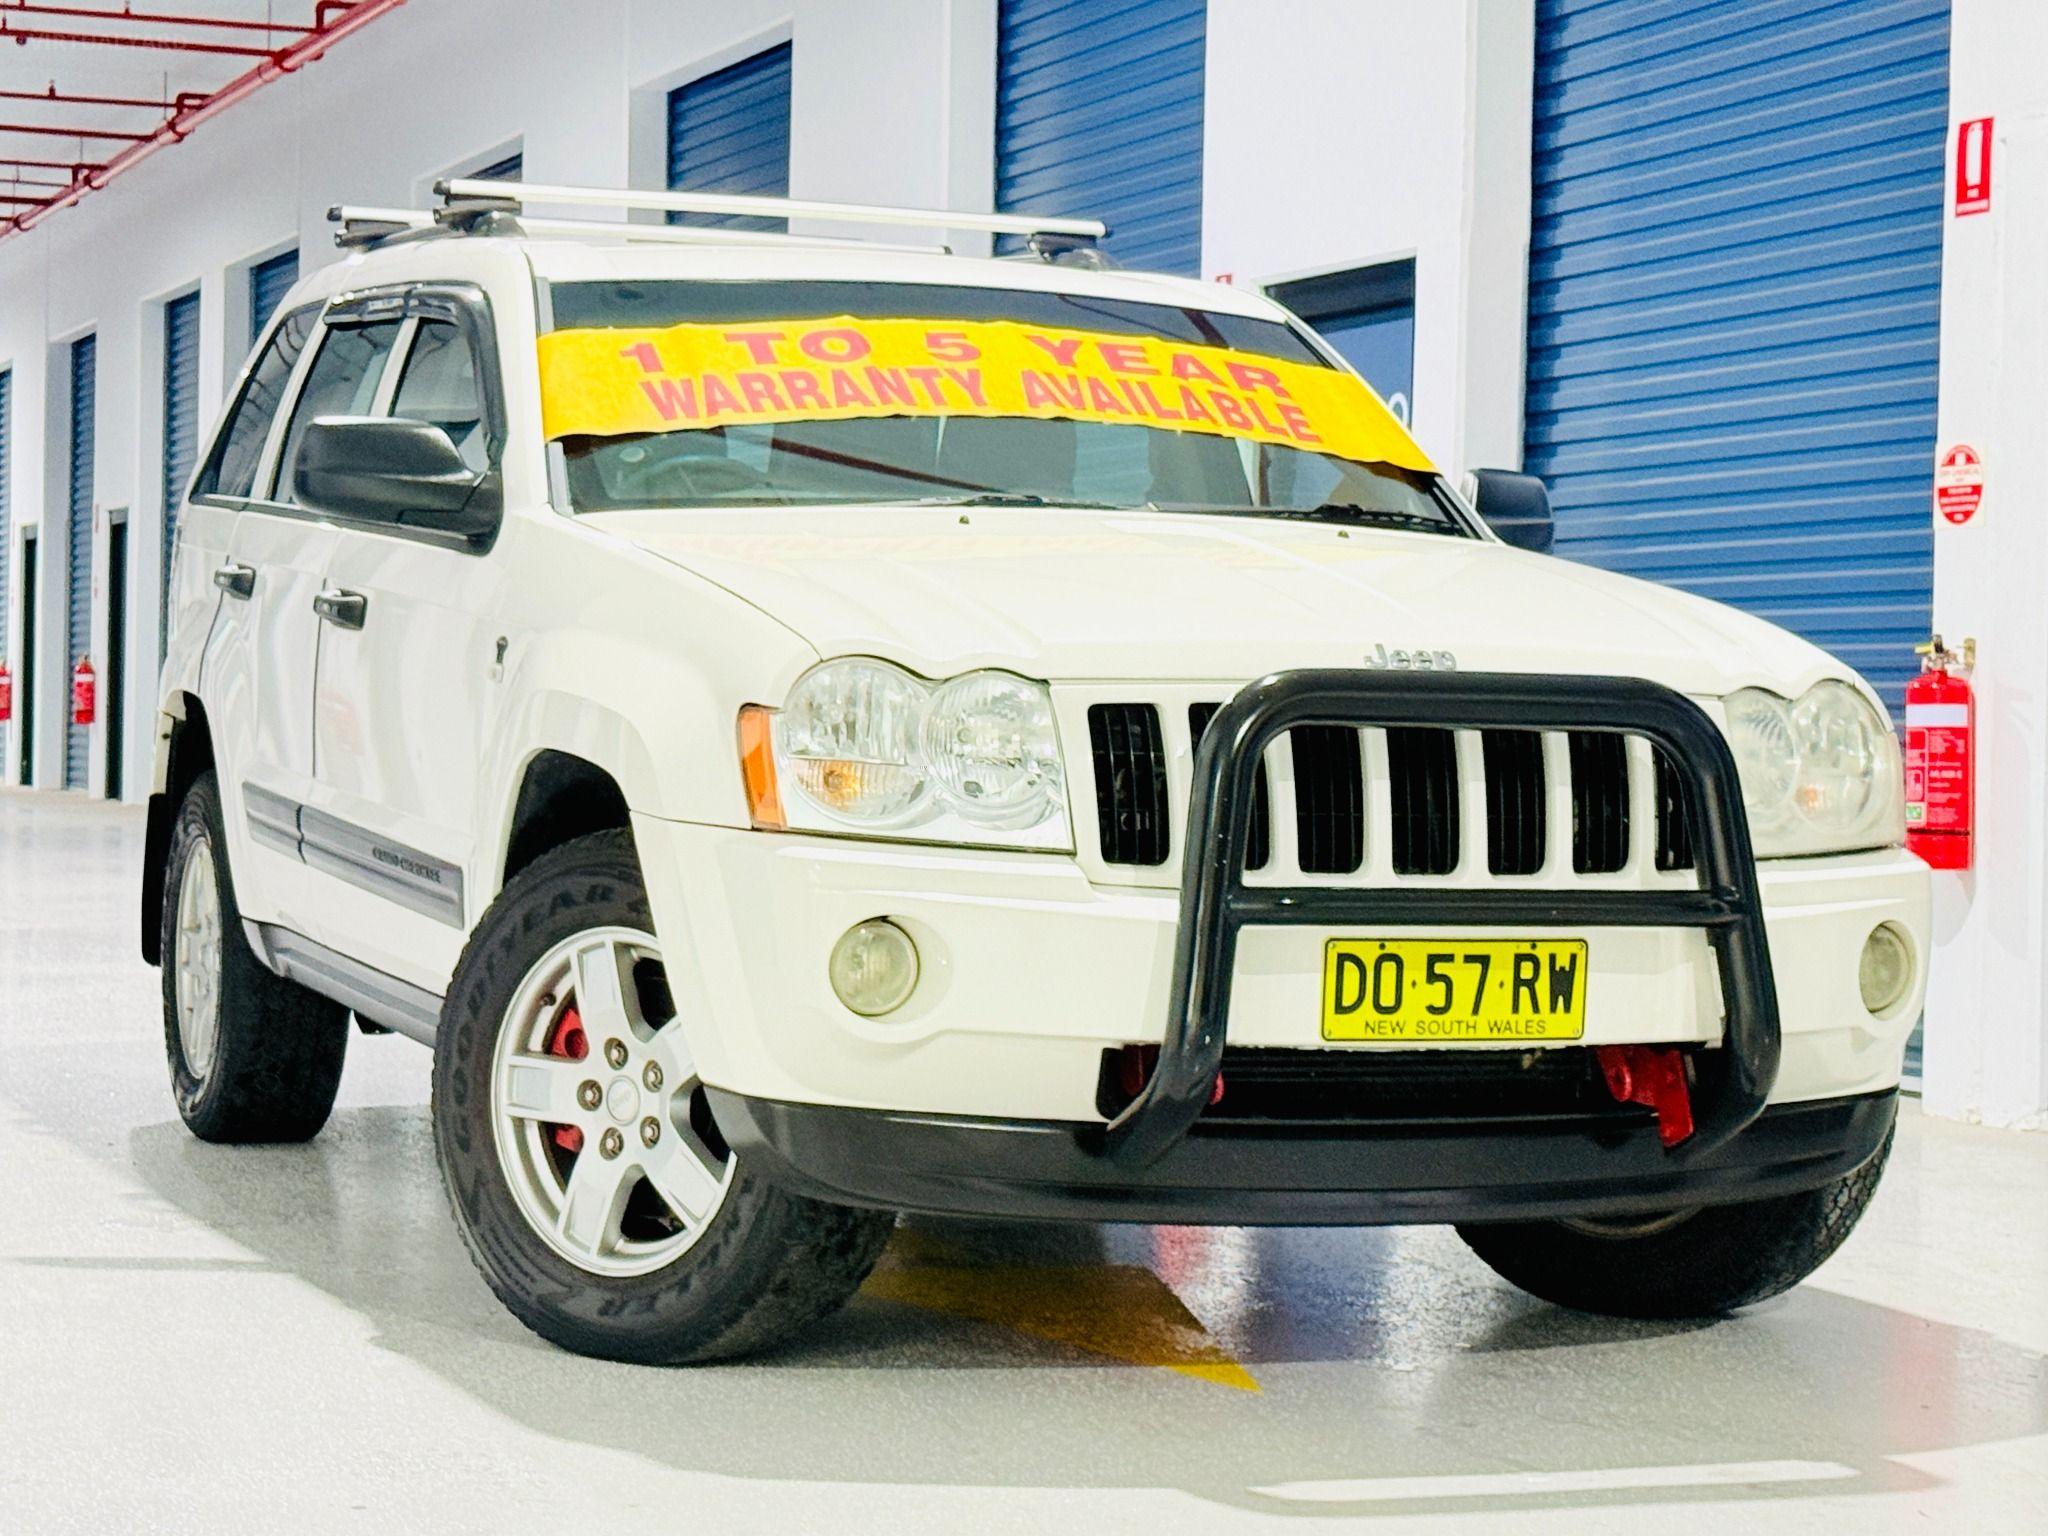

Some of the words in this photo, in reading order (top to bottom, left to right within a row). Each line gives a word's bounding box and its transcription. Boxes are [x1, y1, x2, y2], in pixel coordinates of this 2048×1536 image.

[620, 342, 663, 373] 1
[725, 329, 871, 365] TO
[926, 333, 981, 362] 5
[1028, 334, 1291, 398] YEAR
[643, 366, 986, 420] WARRANTY
[1022, 369, 1322, 442] AVAILABLE
[1363, 643, 1457, 671] Jeep
[1364, 1019, 1406, 1035] NEW
[1415, 1019, 1478, 1035] SOUTH
[1487, 1019, 1548, 1035] WALES
